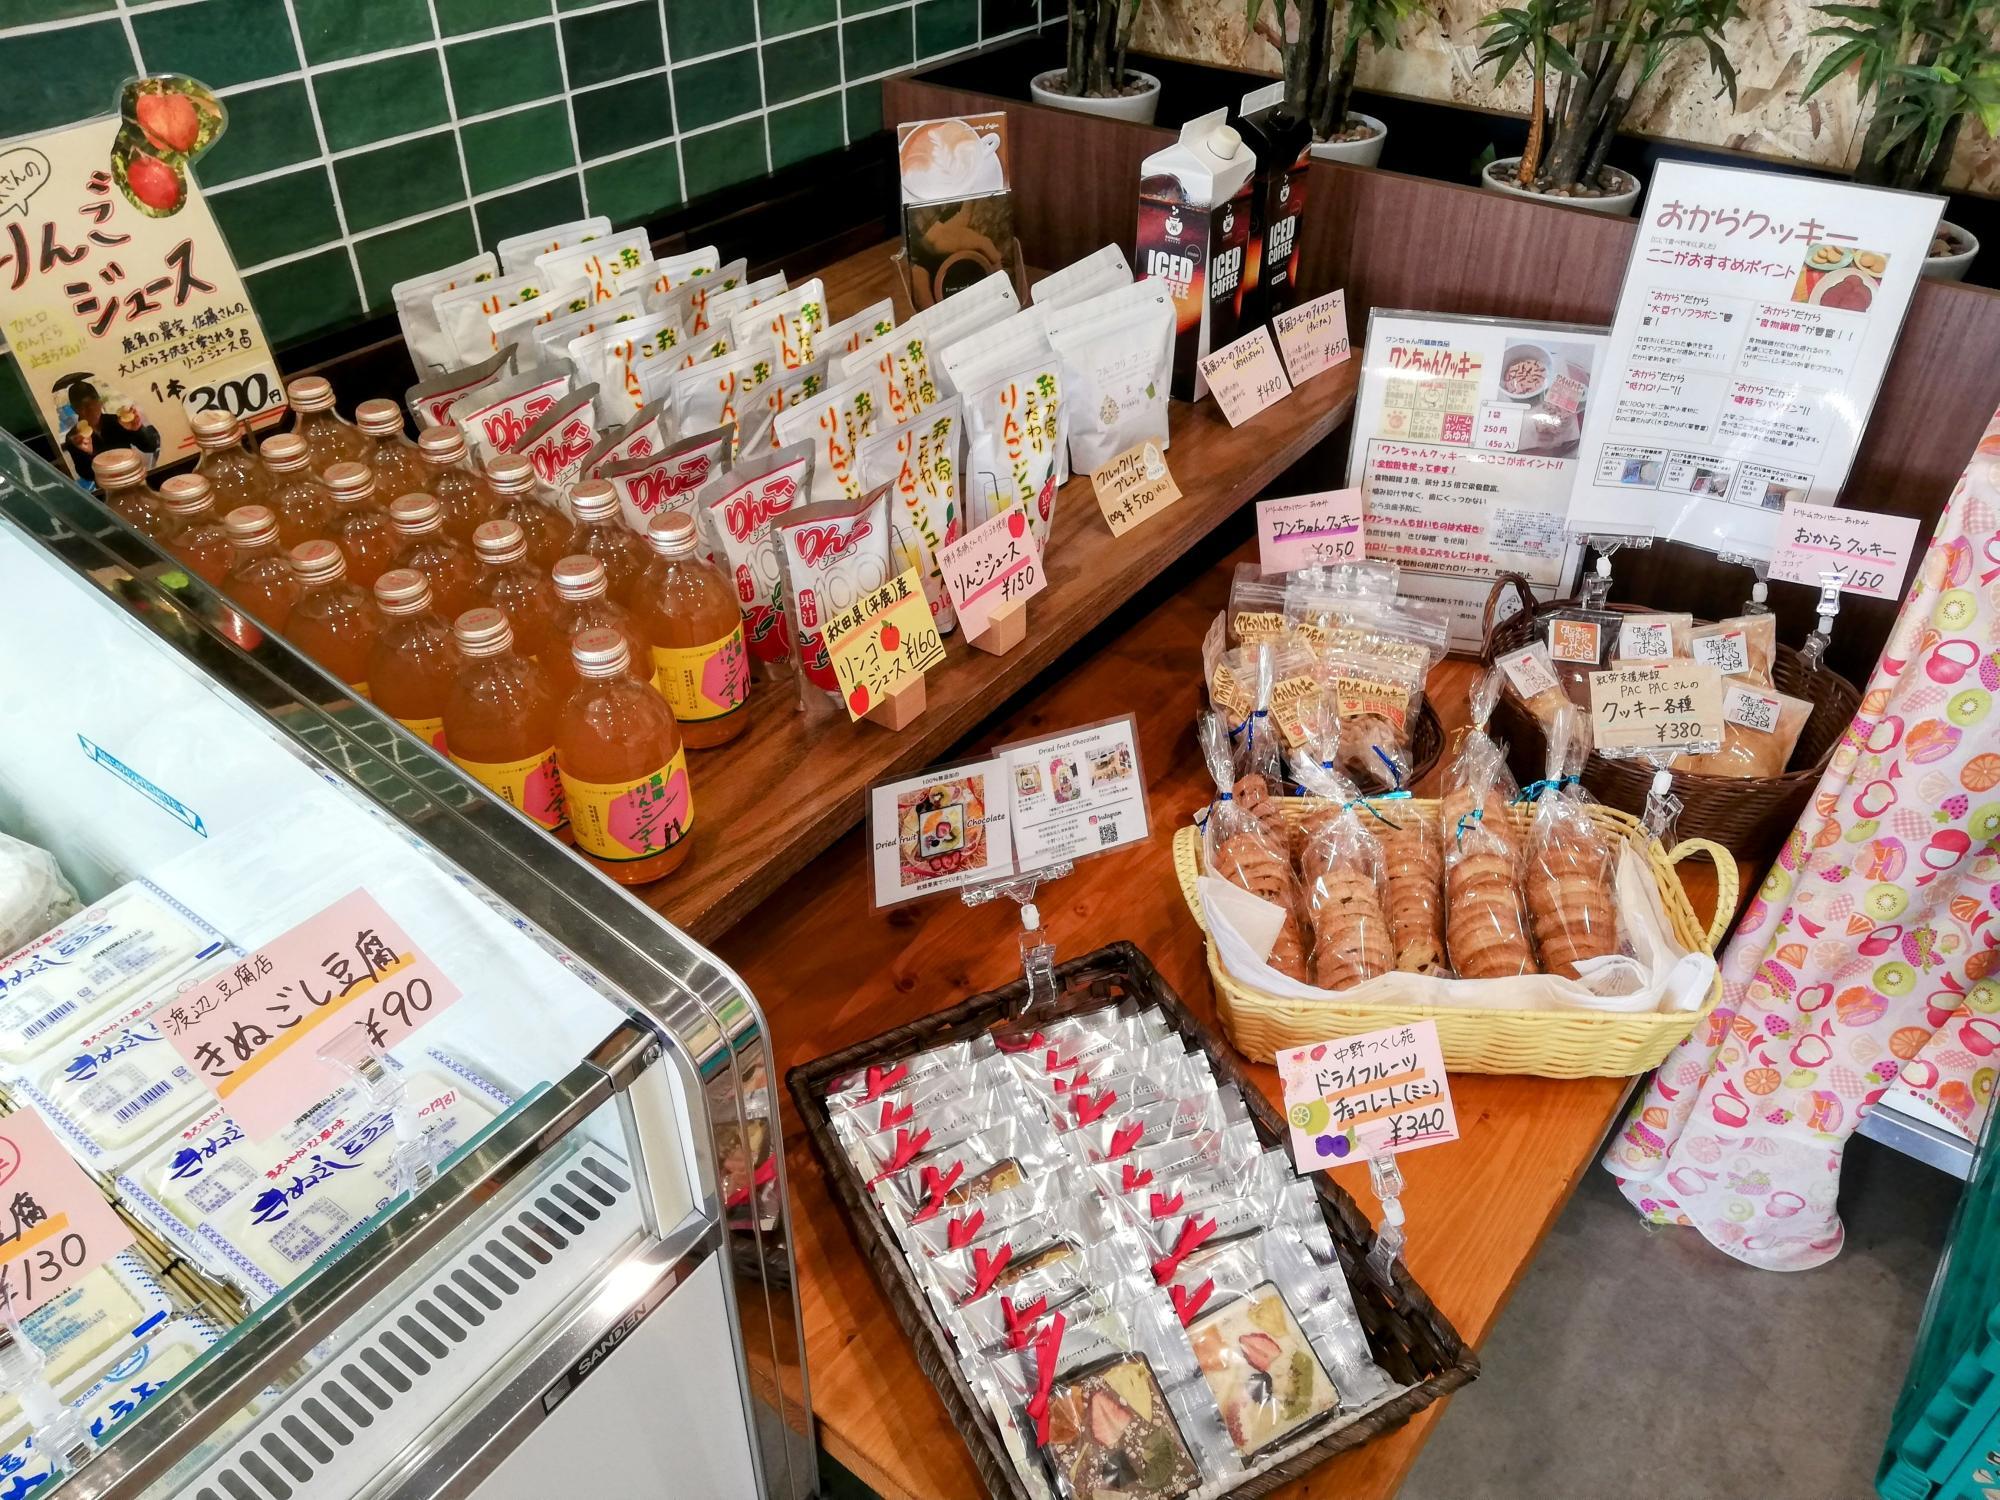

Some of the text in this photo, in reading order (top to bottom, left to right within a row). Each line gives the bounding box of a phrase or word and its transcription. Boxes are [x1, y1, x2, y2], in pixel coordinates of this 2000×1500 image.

[1269, 215, 1296, 250] ICED
[1656, 199, 1858, 246] おからクッキー
[1147, 249, 1193, 284] ICED
[1212, 246, 1241, 282] ICED
[1268, 239, 1293, 265] COFFEE
[1646, 248, 1796, 280] ここがおすすめポイント
[64, 238, 217, 338] ジュース
[1211, 271, 1238, 299] COFFEE
[1389, 346, 1482, 379] ワンちゃんクッキー
[1257, 376, 1281, 404] ¥480
[1114, 466, 1146, 494] ブレンド
[752, 525, 770, 541] ジュー
[1273, 514, 1360, 536] ワンちゃんクッキー
[1794, 527, 1897, 557] おからクッキー
[954, 541, 1020, 602] りんごジュース
[1001, 566, 1034, 602] ¥150
[826, 577, 912, 643] 秋田県(平鹿)産
[840, 631, 878, 683] リンゴ
[900, 629, 937, 666] ¥160
[868, 658, 906, 694] ジュース
[1620, 685, 1642, 698] PAC
[1648, 682, 1669, 695] PAC
[1602, 695, 1695, 723] クッキー各種
[967, 812, 1006, 828] Chocolate
[875, 832, 918, 850] Dried fruit
[193, 928, 402, 1079] きぬごし豆腐
[354, 978, 434, 1049] ¥90
[1334, 1029, 1416, 1063] 中野つくし苑
[1315, 1053, 1417, 1096] ドライフルーツ
[1333, 1079, 1440, 1122] チョコレート(ミニ)
[1389, 1108, 1444, 1146] ¥340
[579, 1302, 647, 1376] SANDEN
